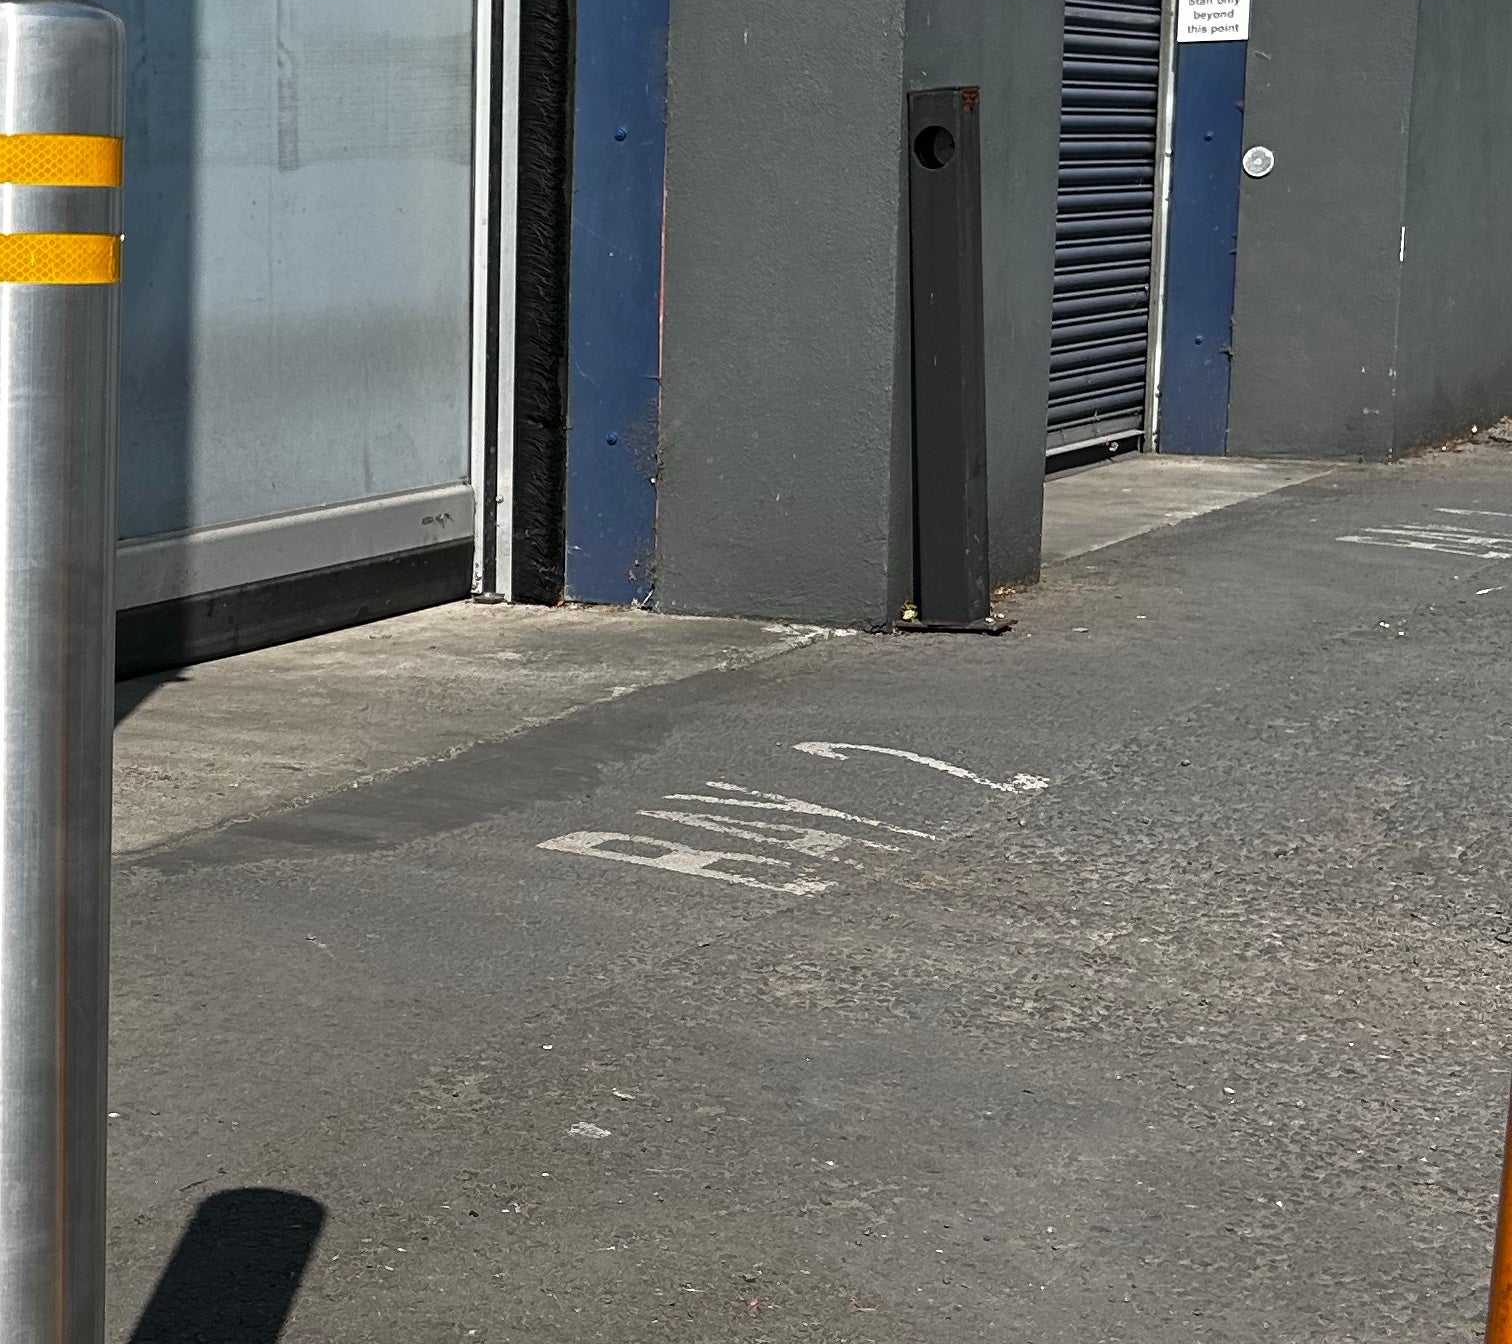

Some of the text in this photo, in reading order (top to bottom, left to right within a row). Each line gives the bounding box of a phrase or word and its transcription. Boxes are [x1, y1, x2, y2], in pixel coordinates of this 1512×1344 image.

[1193, 8, 1235, 21] beyond
[1187, 23, 1239, 35] this point
[536, 780, 940, 897] BAY
